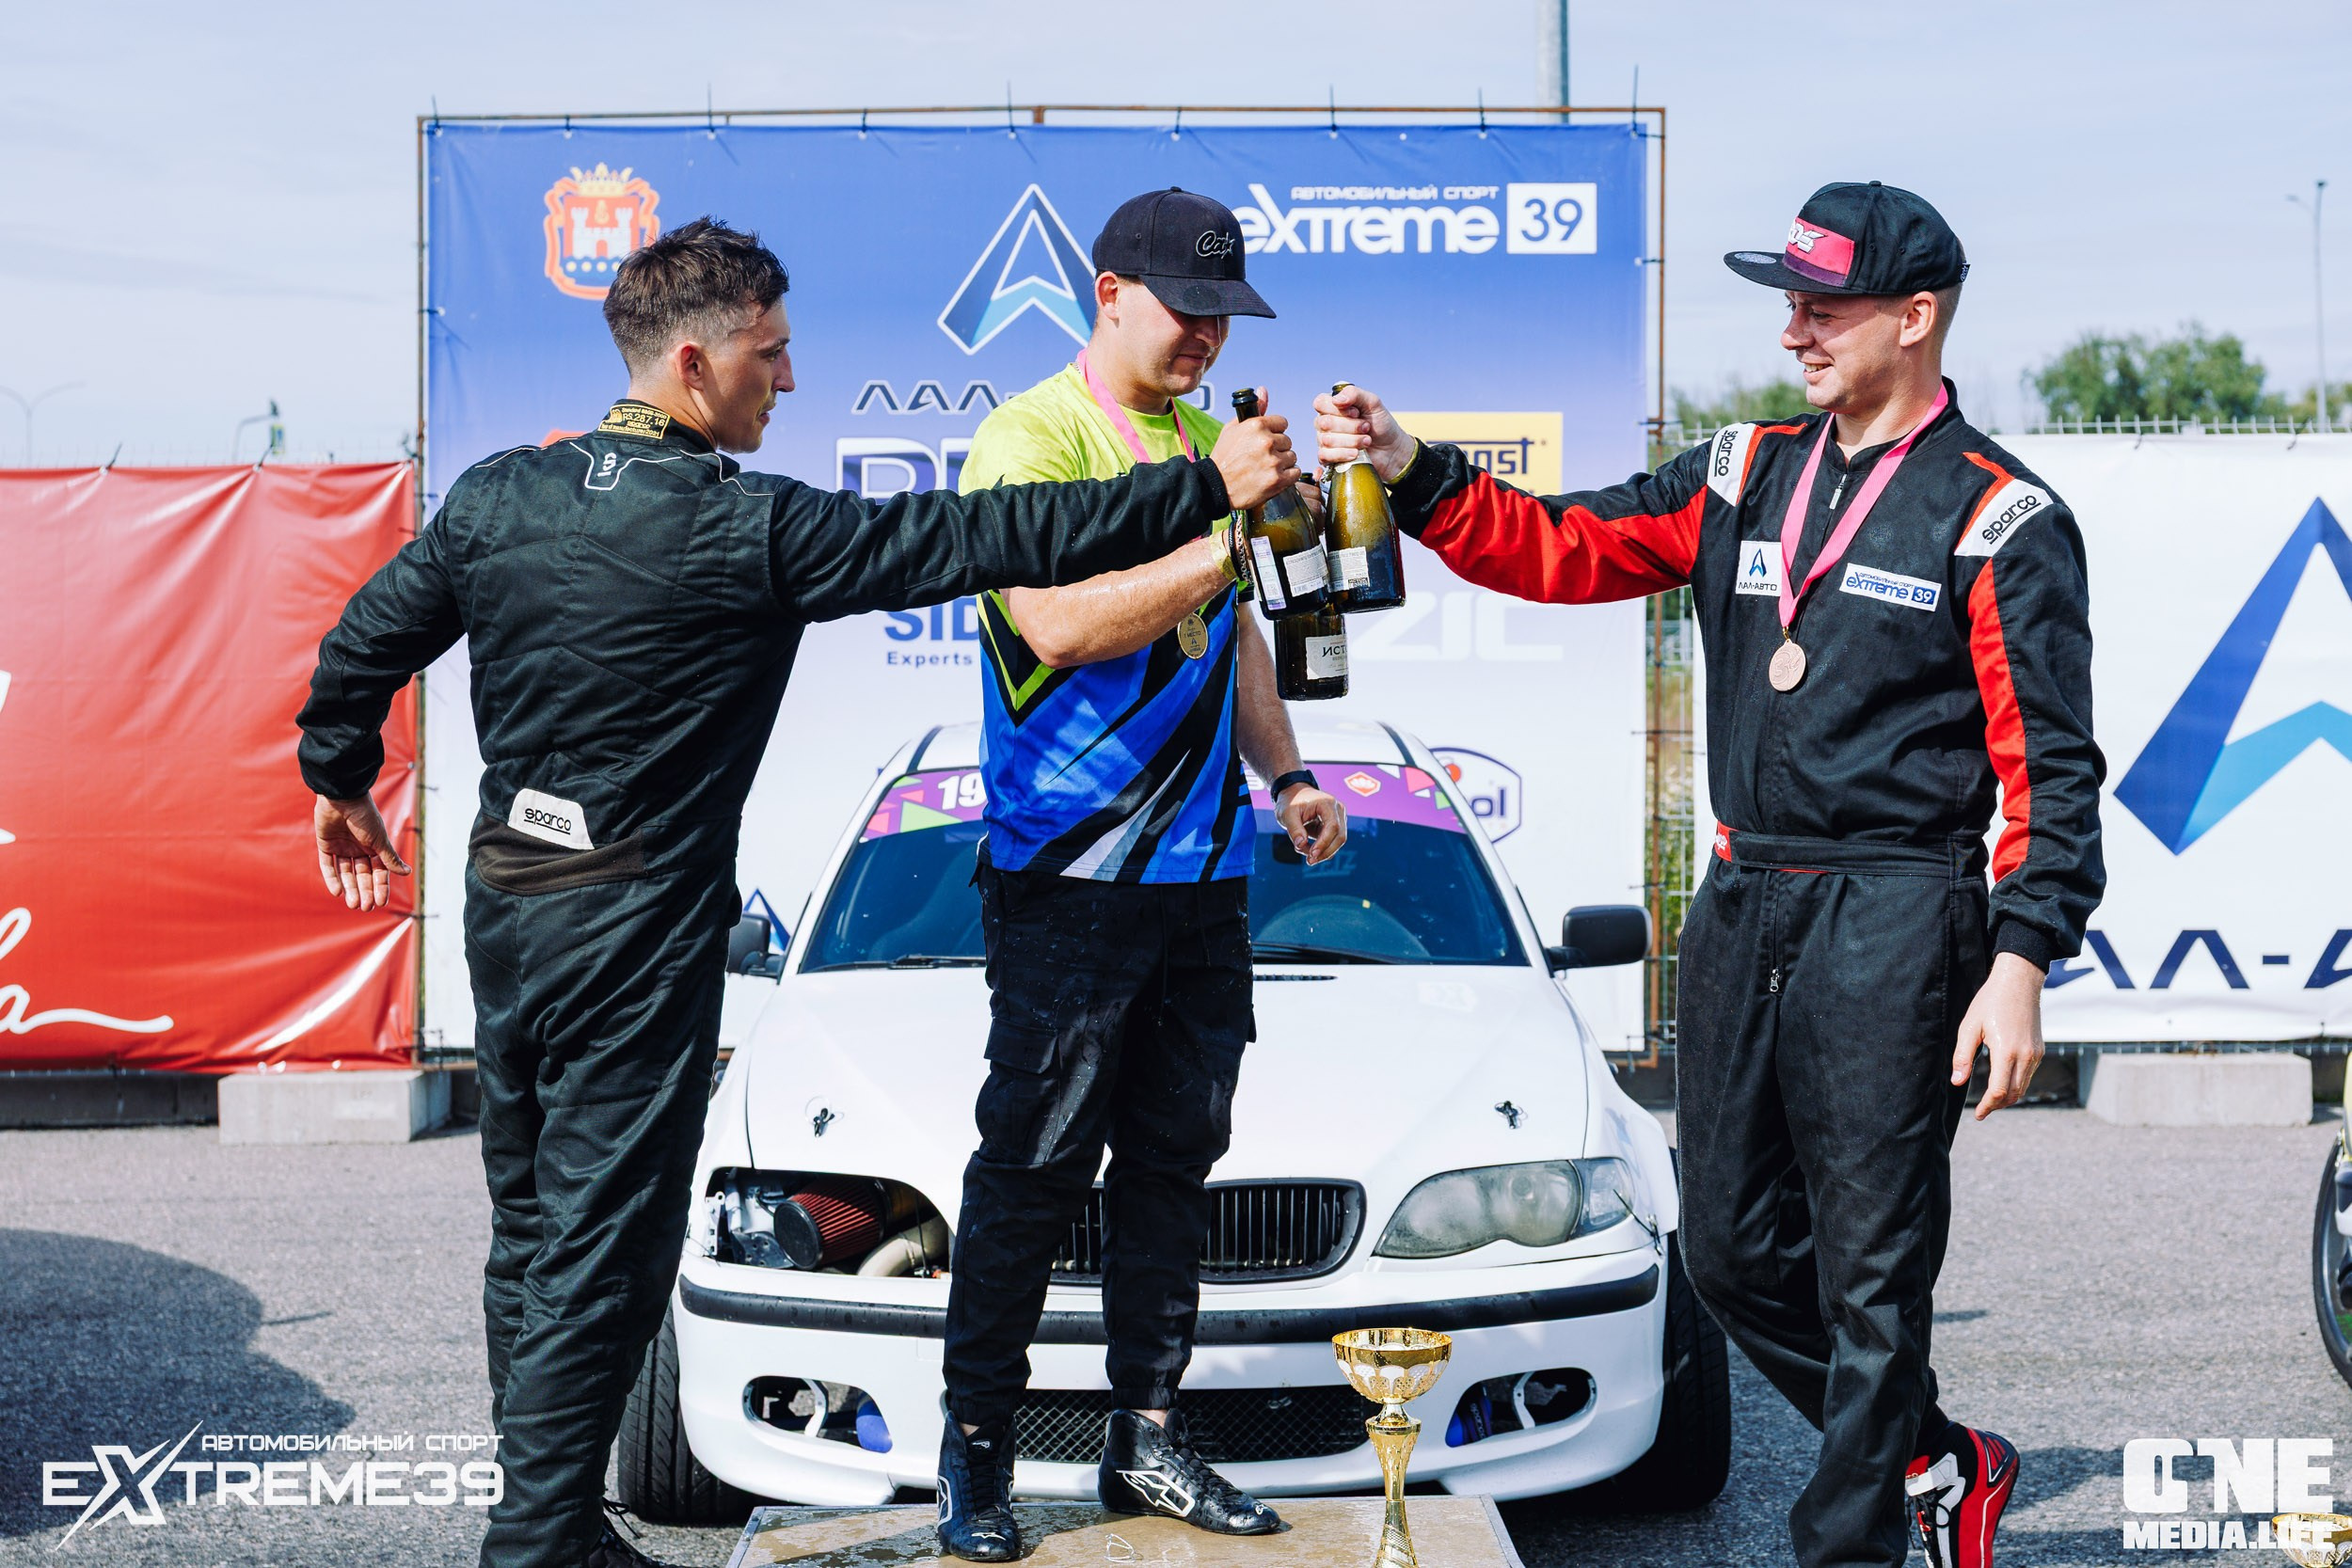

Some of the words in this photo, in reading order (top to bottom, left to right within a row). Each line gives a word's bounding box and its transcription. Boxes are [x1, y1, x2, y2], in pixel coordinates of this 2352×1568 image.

[1291, 184, 1438, 200] АВТОМОБИЛЬНЫЙ
[1443, 185, 1500, 200] СПОРТ
[1520, 198, 1583, 242] 39
[1715, 430, 1739, 477] sparco
[1982, 495, 2039, 543] sparco
[1915, 588, 1933, 603] 39
[1352, 592, 1564, 660] ZIC
[887, 652, 973, 669] Experts
[1322, 644, 1348, 657] ИСТ
[524, 807, 572, 833] sparco
